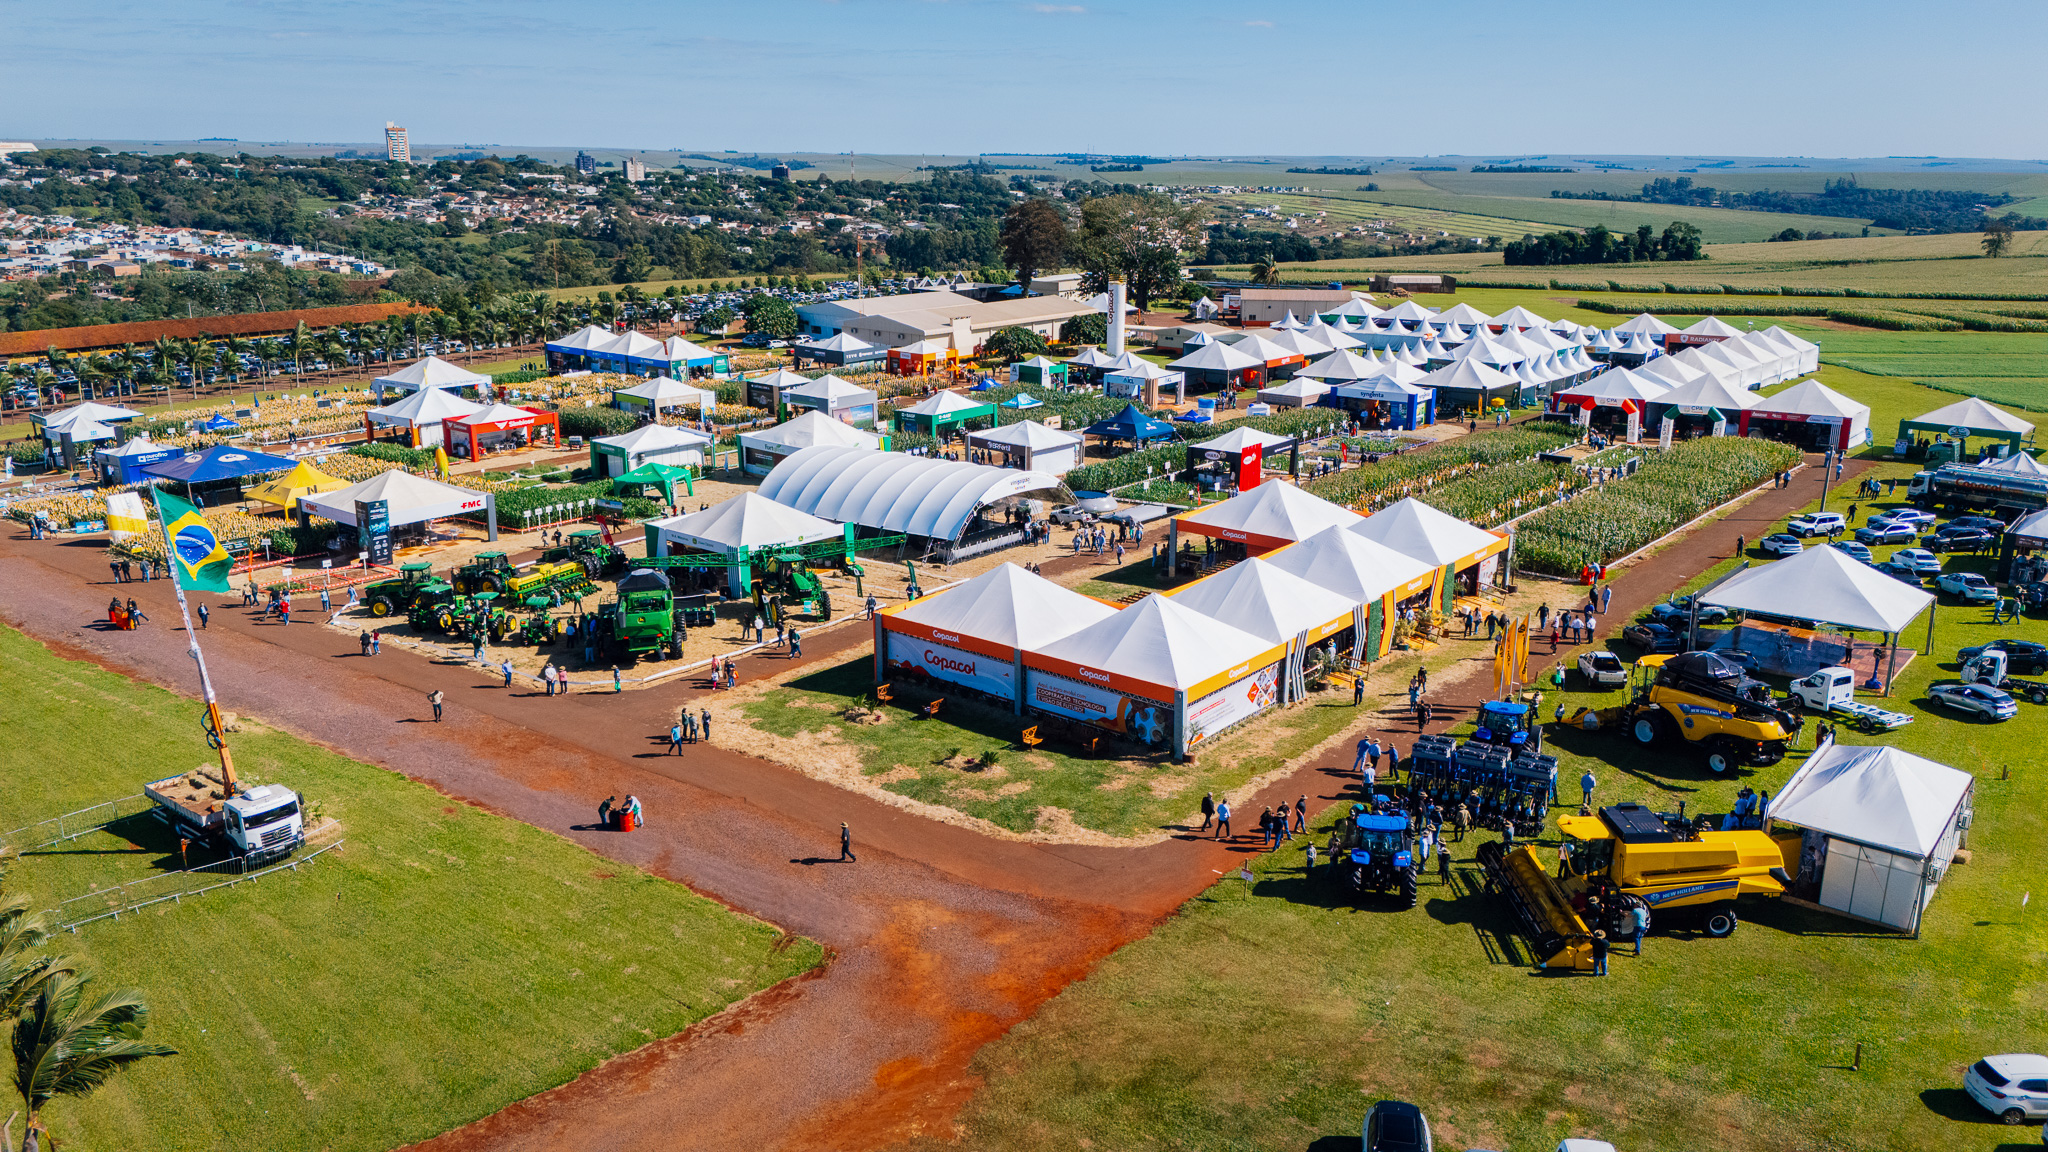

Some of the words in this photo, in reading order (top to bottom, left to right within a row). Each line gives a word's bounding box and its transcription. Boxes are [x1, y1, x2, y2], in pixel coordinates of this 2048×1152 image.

[509, 418, 534, 427] Simbiose
[1956, 478, 2002, 492] Copacol
[460, 500, 481, 509] FMC
[1222, 529, 1247, 540] Copacol
[1474, 548, 1487, 560] Copacol
[1407, 577, 1423, 591] Copacol
[1321, 620, 1339, 634] Copacol
[932, 629, 960, 643] Copacol
[923, 649, 977, 676] Copacol
[1078, 667, 1110, 683] Copacol
[1228, 662, 1250, 679] Copacol
[1072, 698, 1105, 712] TECNOLOGIA
[1662, 891, 1676, 899] NEW
[1677, 885, 1704, 896] HOLLAND
